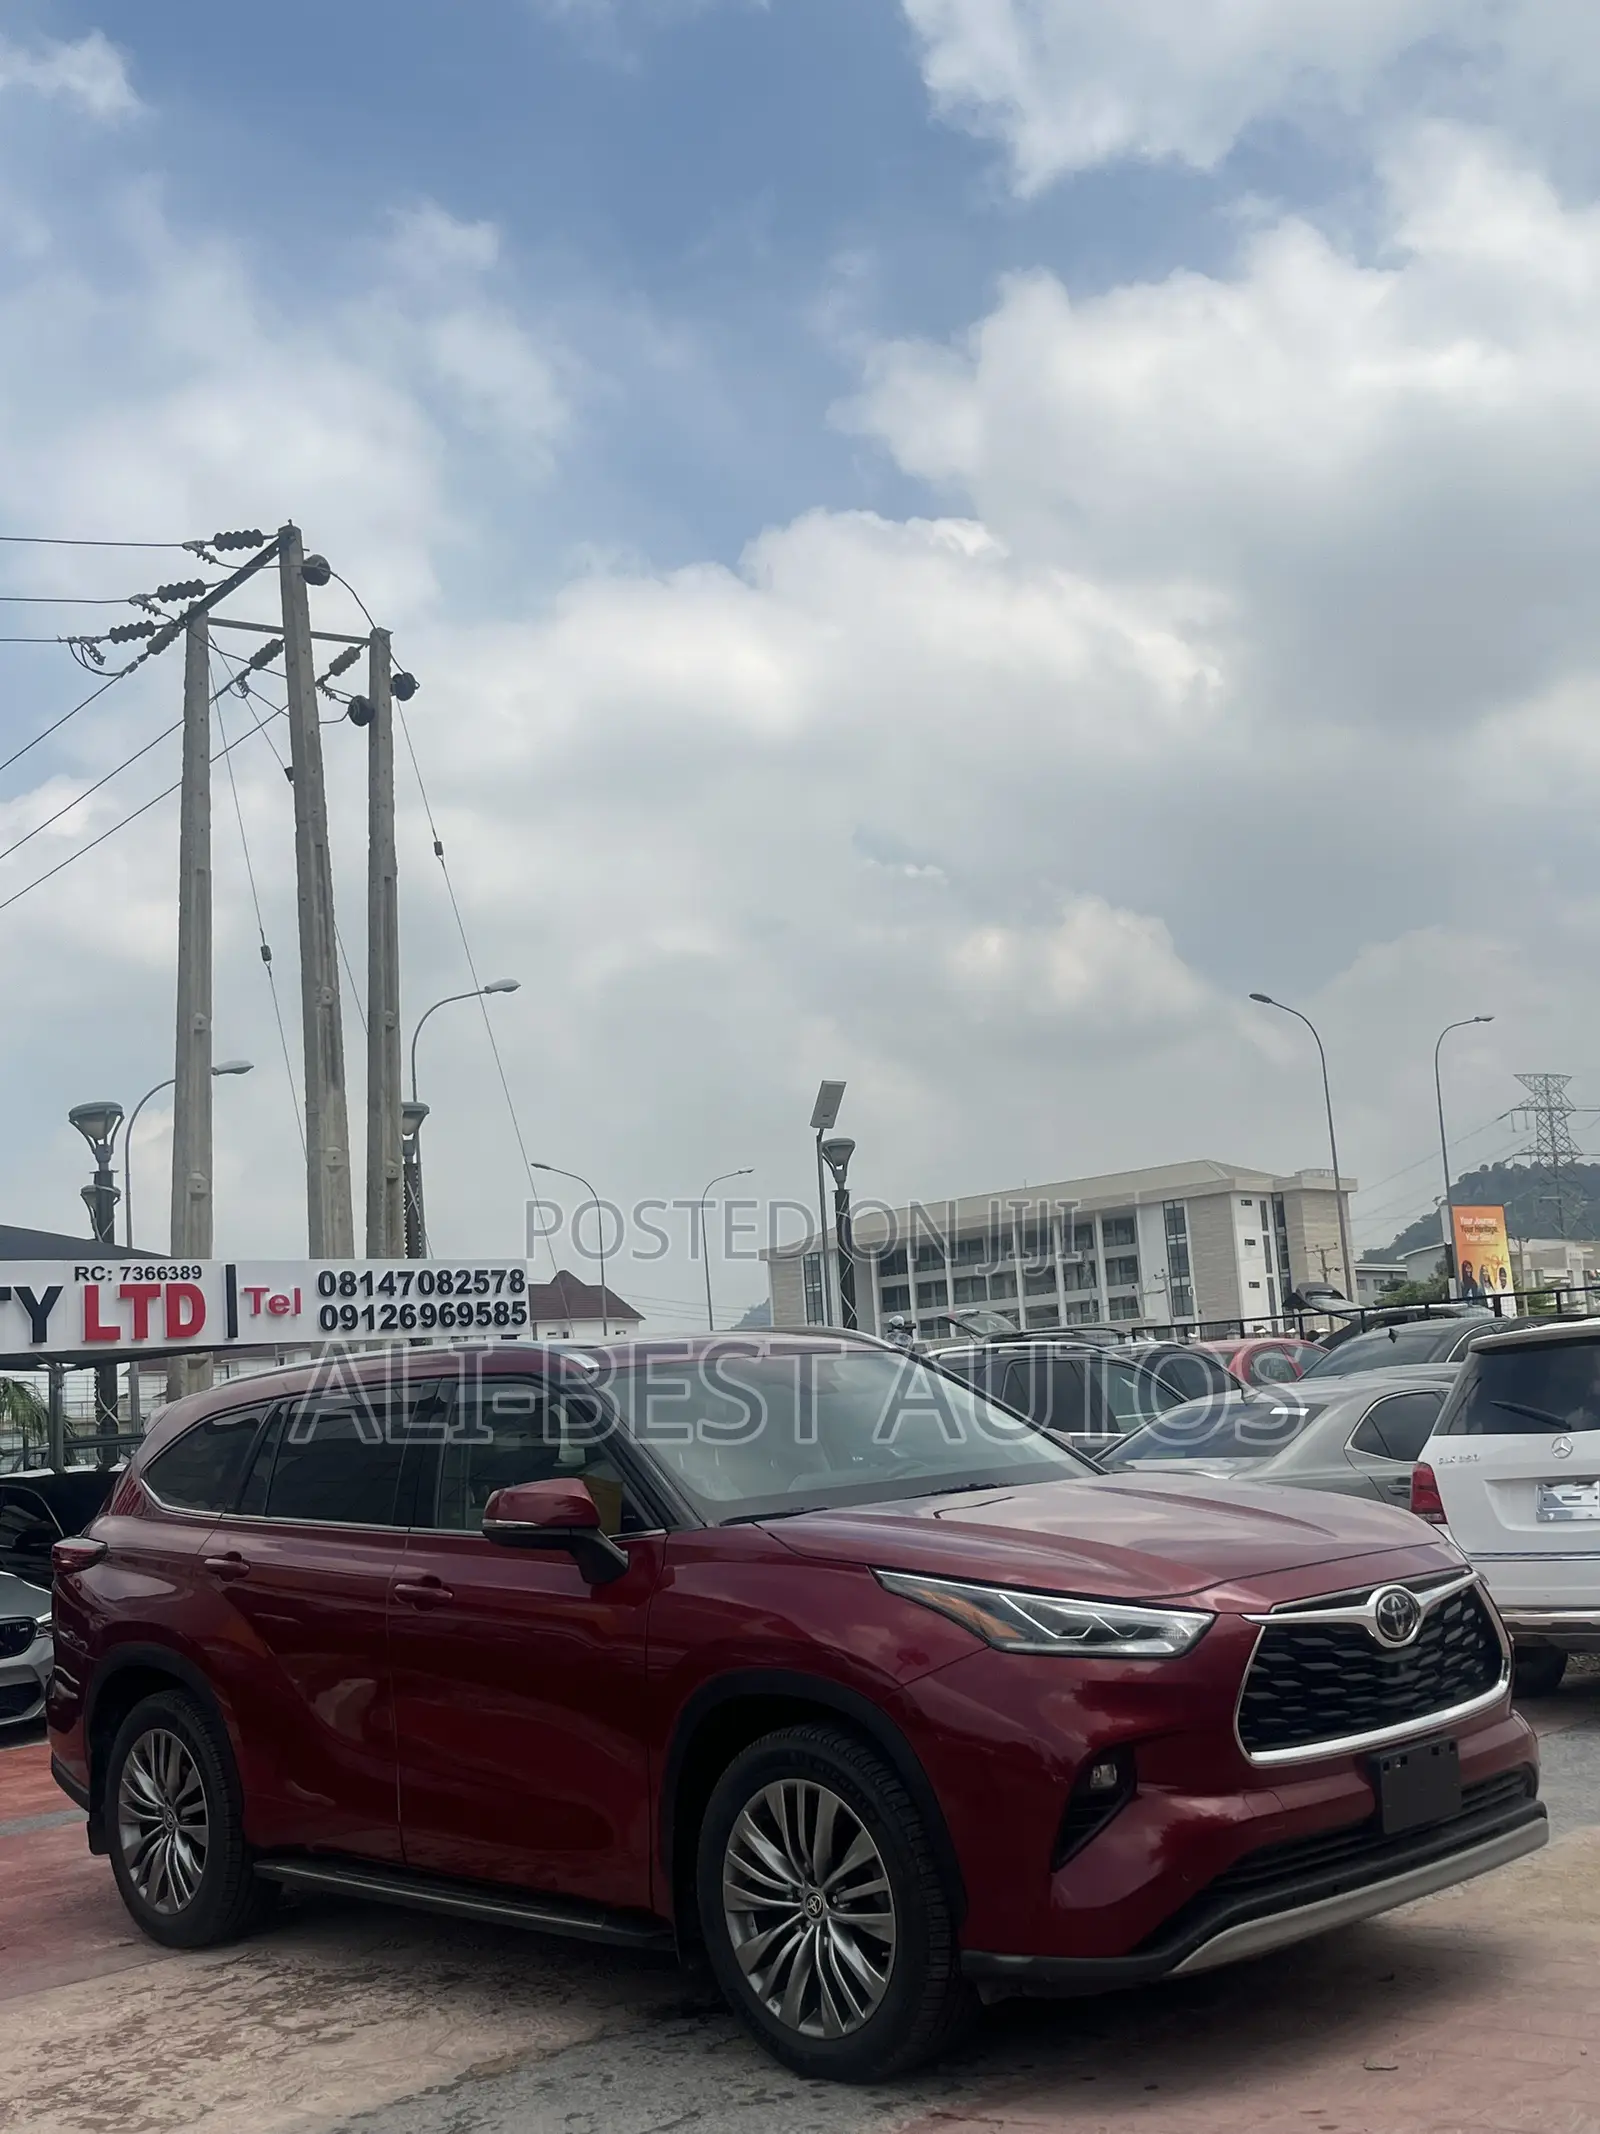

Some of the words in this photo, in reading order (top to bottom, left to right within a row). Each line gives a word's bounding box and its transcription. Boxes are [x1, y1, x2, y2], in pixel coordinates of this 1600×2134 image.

[74, 1266, 113, 1282] RC:
[119, 1265, 203, 1282] 7366389
[317, 1268, 526, 1298] 08147082578
[0, 1285, 64, 1344] Y
[83, 1283, 207, 1342] LTD
[243, 1286, 302, 1316] Tel
[319, 1300, 528, 1331] 09126969585
